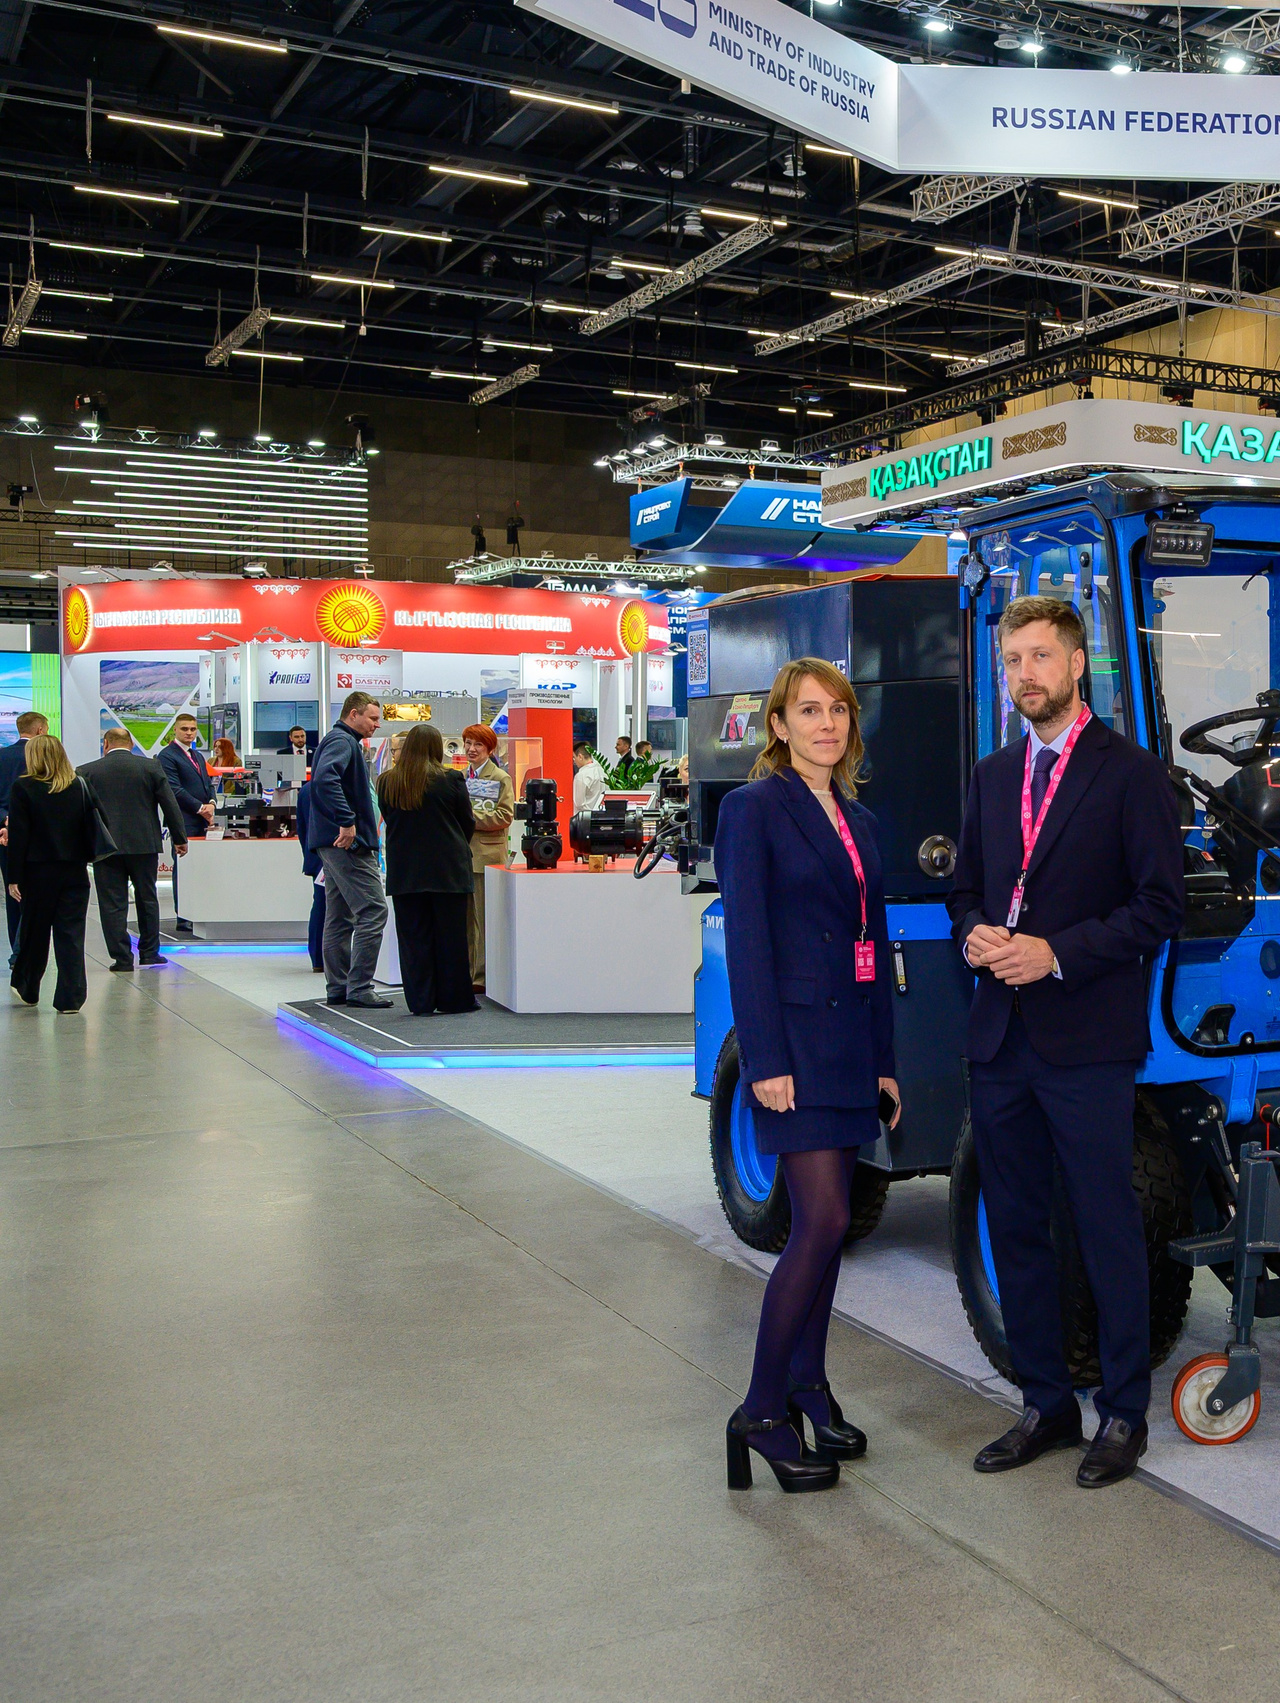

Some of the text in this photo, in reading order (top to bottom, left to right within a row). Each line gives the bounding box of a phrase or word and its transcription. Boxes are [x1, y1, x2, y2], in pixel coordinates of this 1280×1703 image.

[708, 1, 875, 98] MINISTRY OF INDUSTRY
[708, 30, 870, 123] AND TRADE OF RUSSIA
[992, 106, 1115, 131] RUSSIAN
[869, 436, 992, 501] ҚАЗАҚСТАН
[793, 499, 822, 512] НА
[355, 678, 391, 686] DASTAN
[705, 914, 724, 930] МИ
